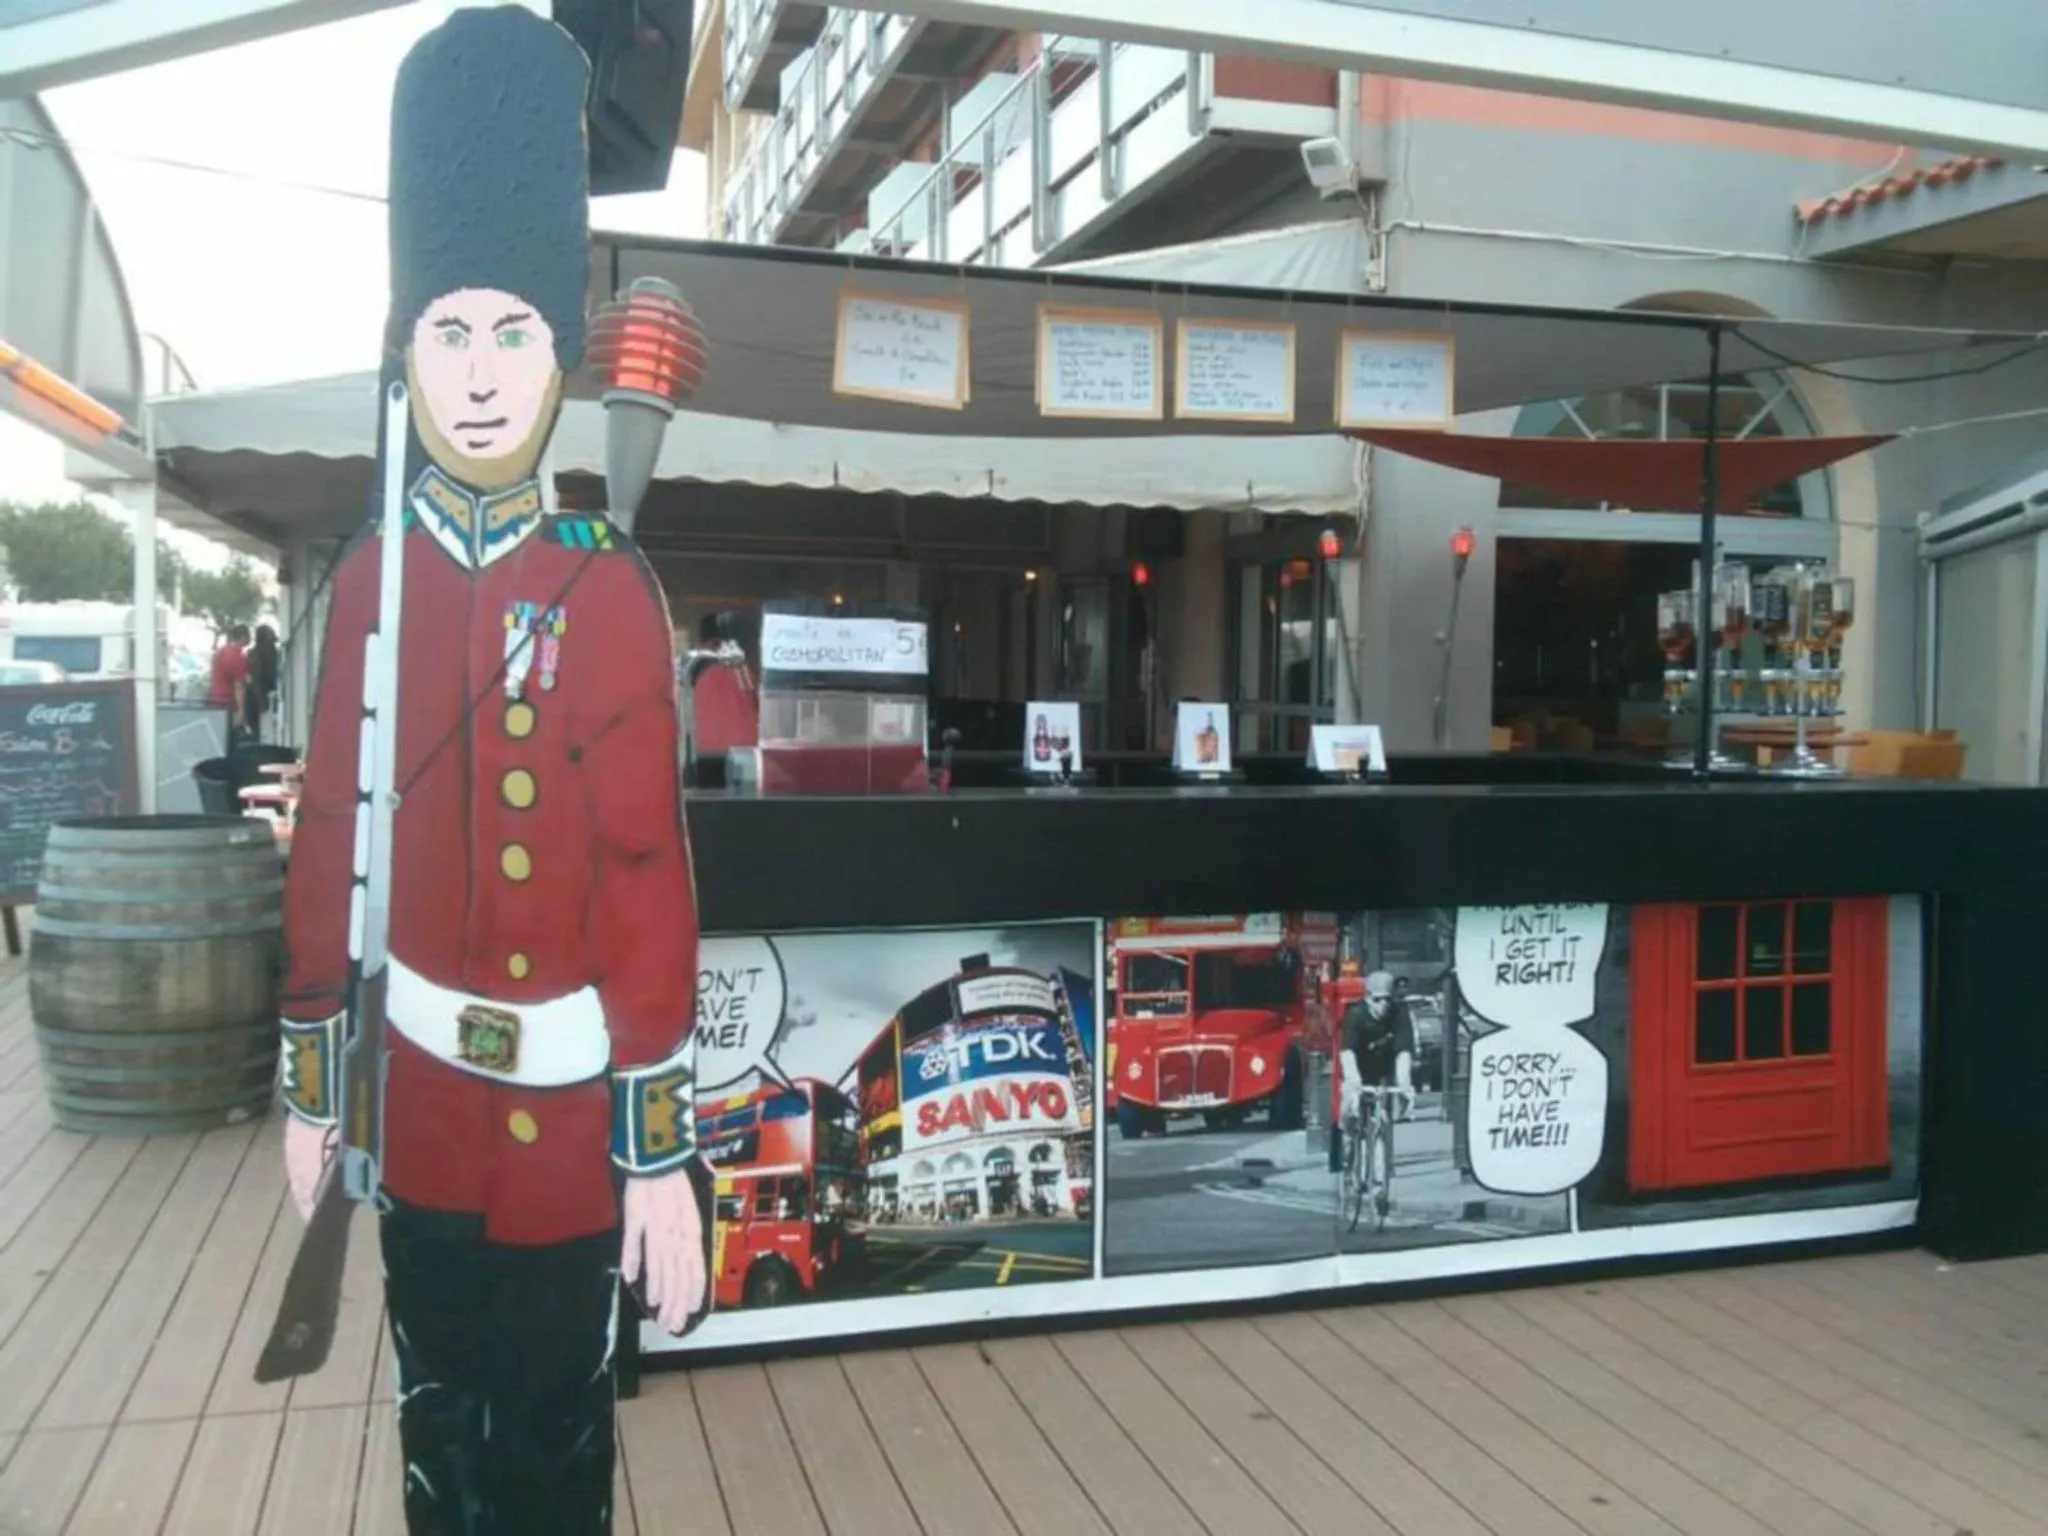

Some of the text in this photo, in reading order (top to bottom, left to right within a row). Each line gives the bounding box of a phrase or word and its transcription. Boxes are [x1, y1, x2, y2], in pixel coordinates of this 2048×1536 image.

[771, 644, 887, 664] COSMOPOLITAN
[1501, 913, 1567, 935] UNTIL
[1489, 935, 1582, 961] I GET IT
[696, 967, 764, 993] ON'T
[1495, 961, 1576, 986] RIGHT!
[696, 996, 747, 1021] AVE
[695, 1022, 749, 1049] ME!
[950, 1031, 1056, 1068] TDK
[1481, 1052, 1577, 1077] SORRY...
[1486, 1075, 1574, 1101] I DON'T
[916, 1080, 1068, 1138] SANYO
[1498, 1099, 1560, 1124] HAVE
[1488, 1123, 1569, 1151] TIME!!!
